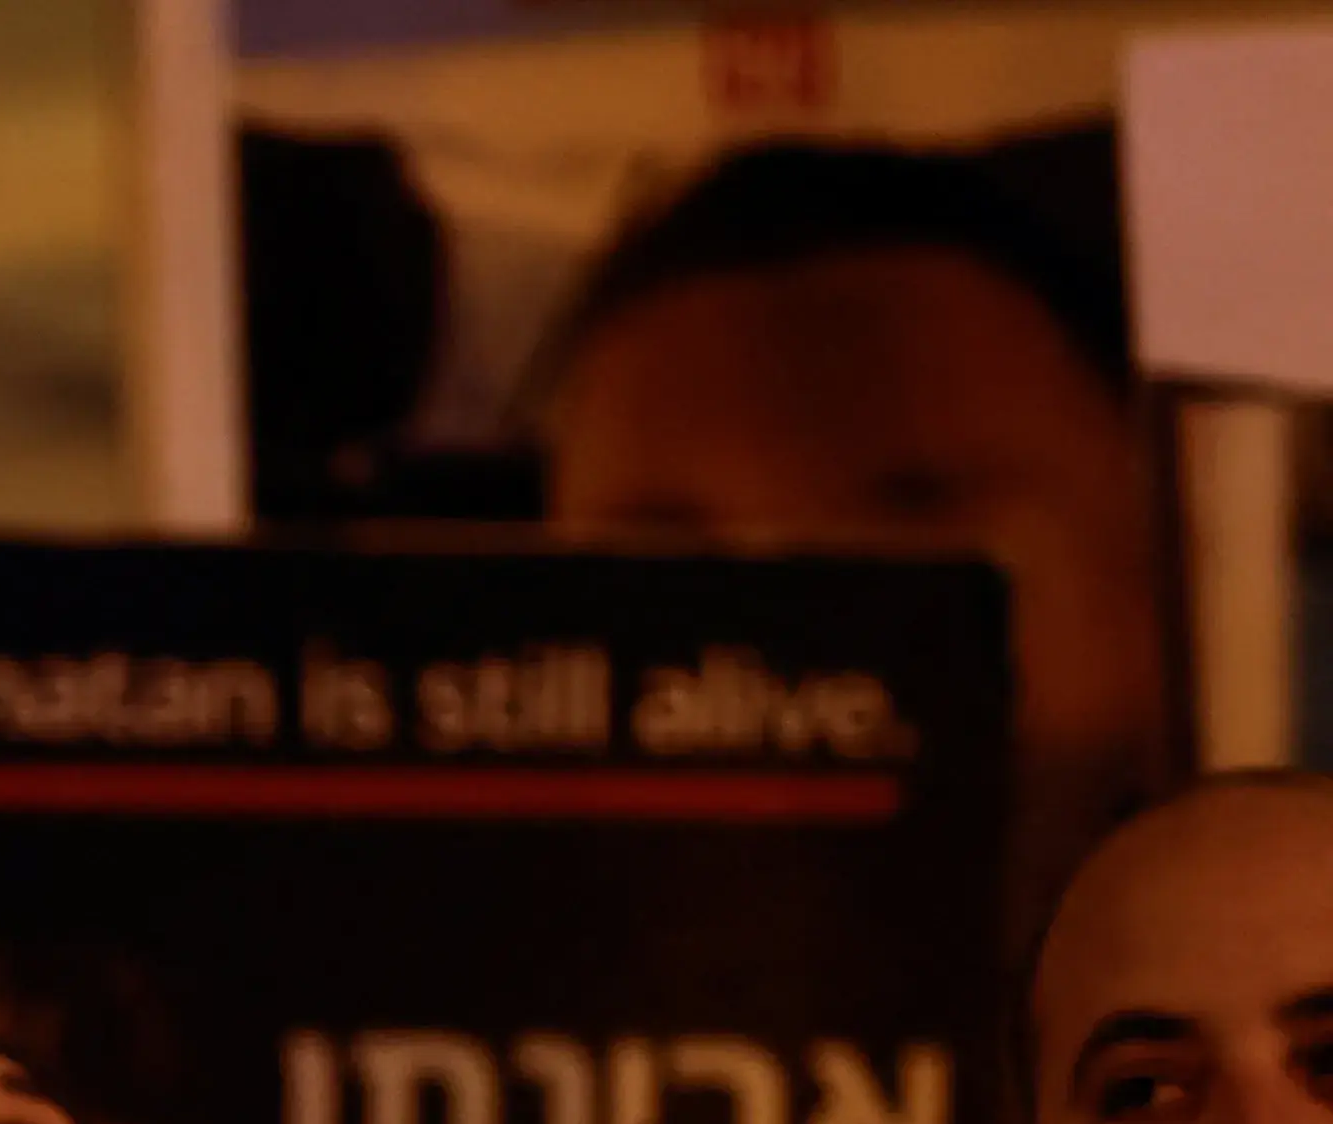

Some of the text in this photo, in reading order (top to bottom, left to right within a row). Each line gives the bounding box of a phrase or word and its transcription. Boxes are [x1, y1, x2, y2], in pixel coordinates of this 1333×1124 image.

[299, 632, 396, 750] is
[414, 636, 614, 754] still
[631, 640, 920, 760] alive.
